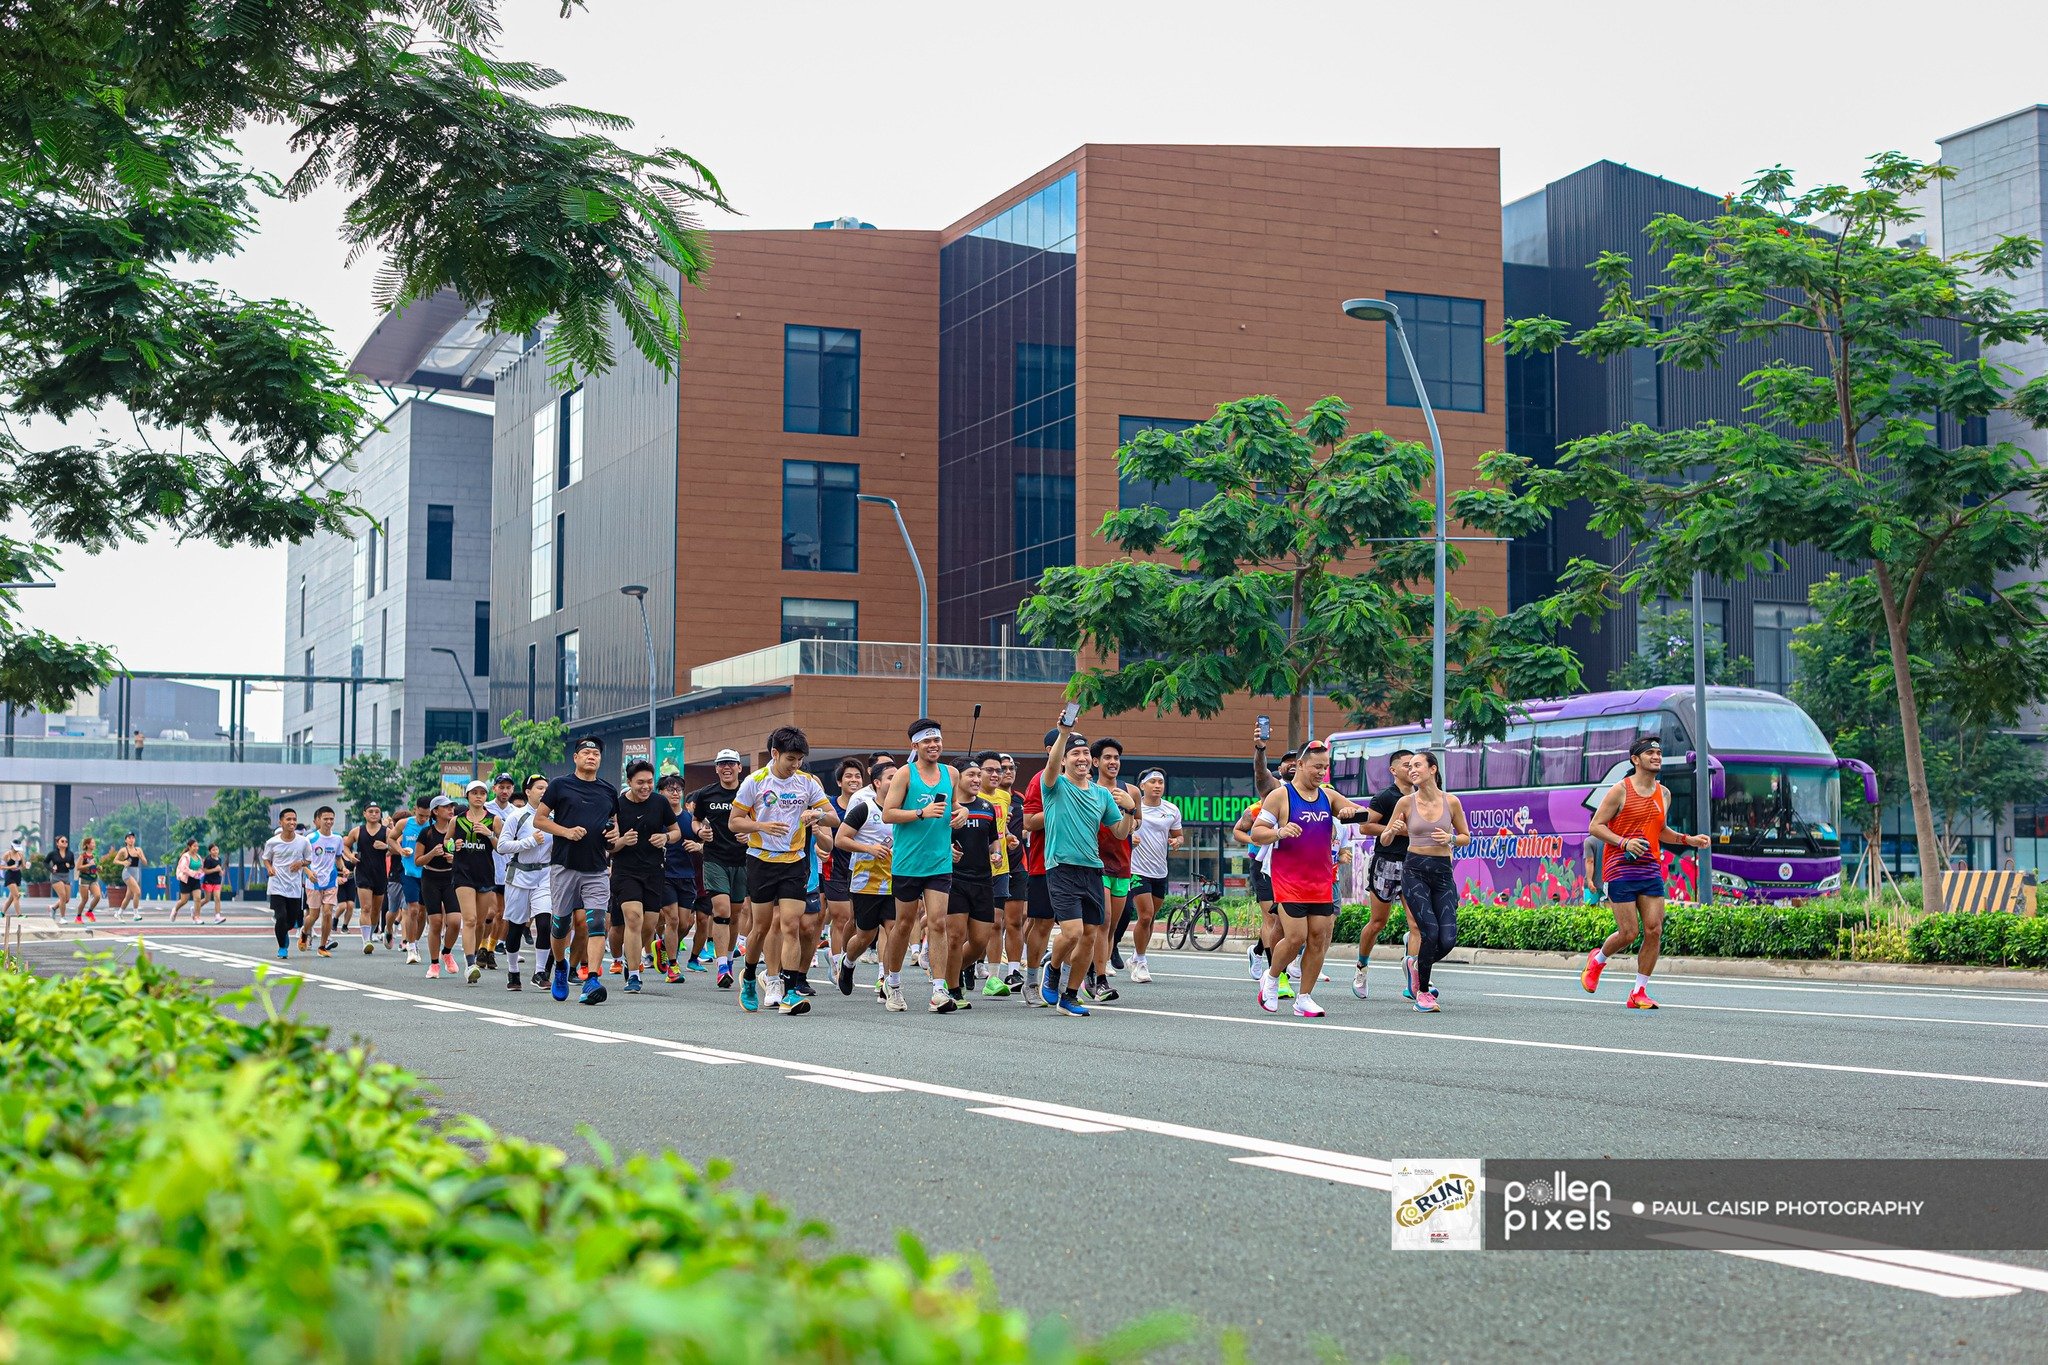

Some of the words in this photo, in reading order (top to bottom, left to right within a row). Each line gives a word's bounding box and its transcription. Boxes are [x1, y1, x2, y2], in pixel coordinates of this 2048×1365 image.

[1162, 796, 1209, 821] OME
[1212, 796, 1260, 821] DEPO
[964, 819, 979, 828] HI
[1470, 808, 1514, 829] UNION
[461, 839, 486, 850] olorun
